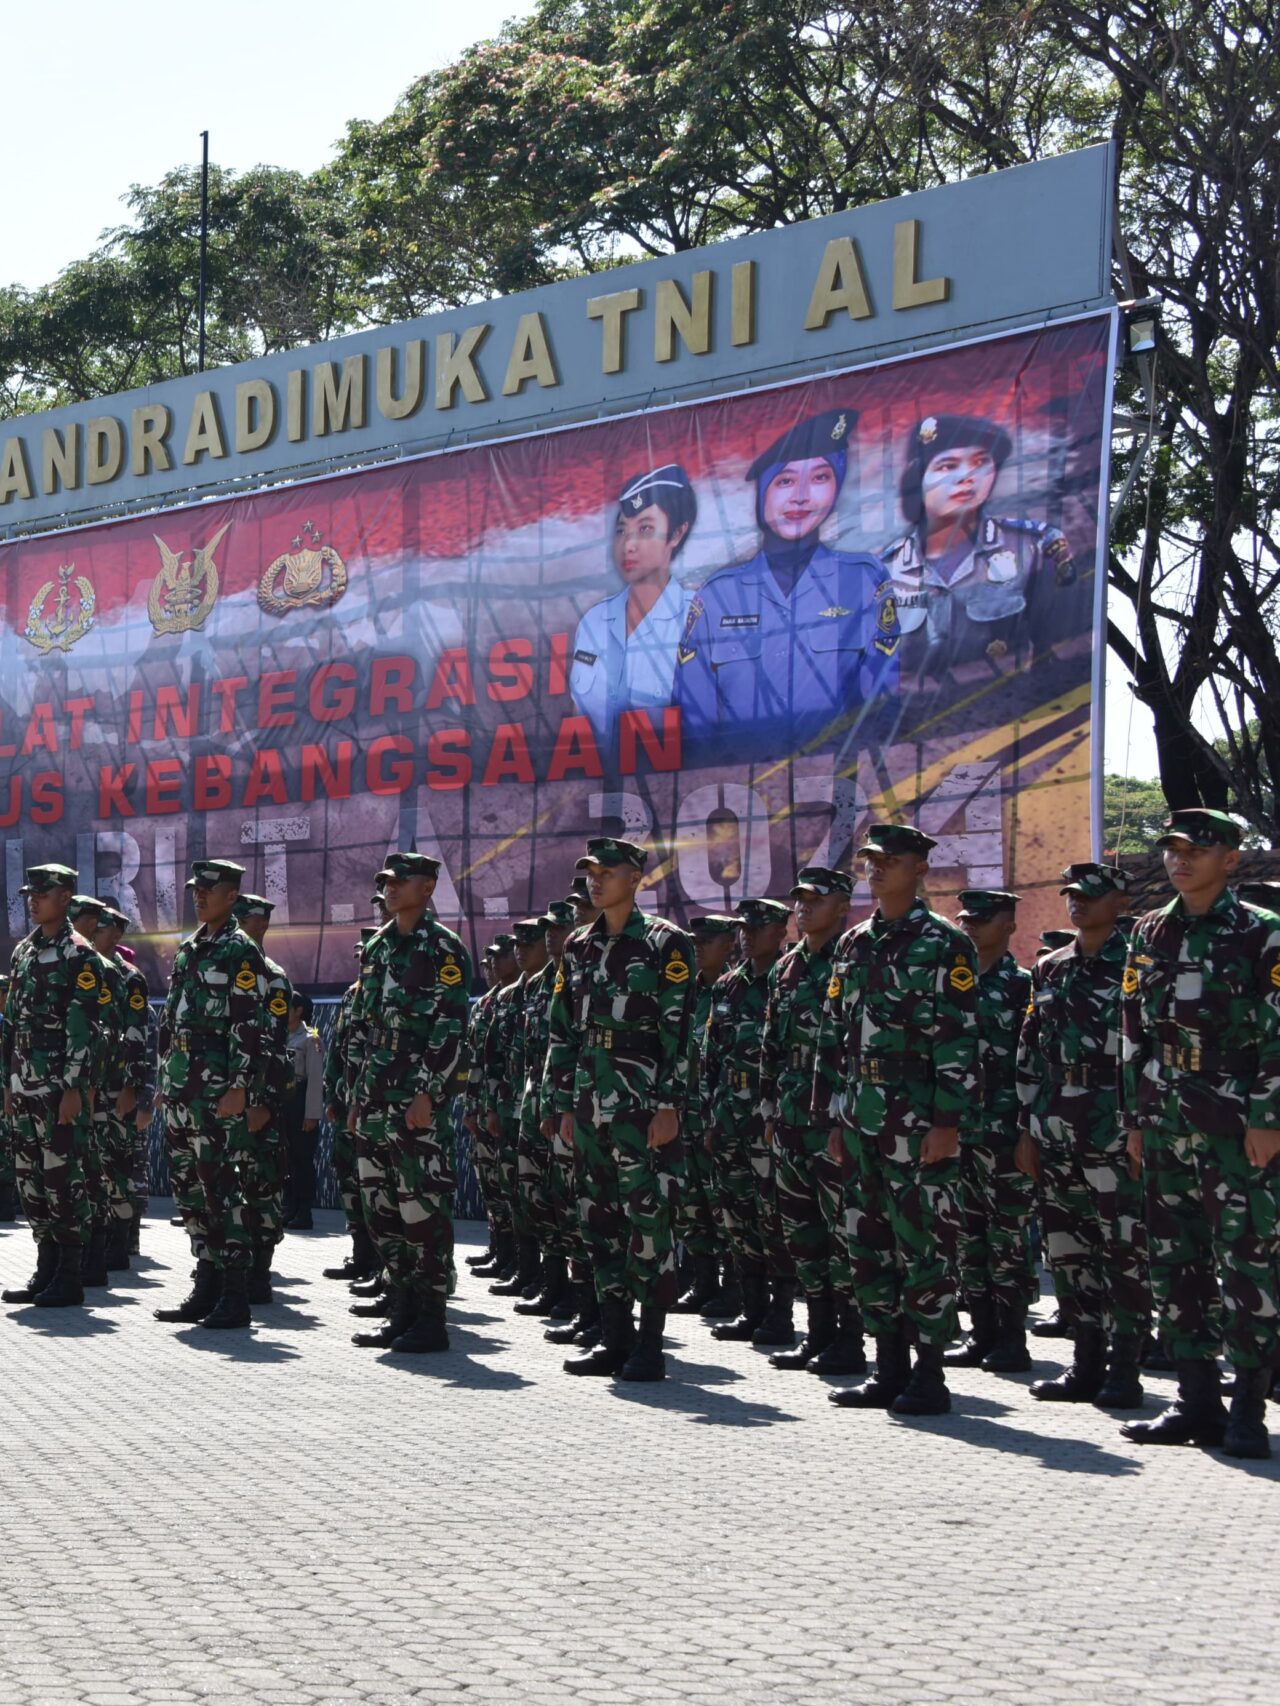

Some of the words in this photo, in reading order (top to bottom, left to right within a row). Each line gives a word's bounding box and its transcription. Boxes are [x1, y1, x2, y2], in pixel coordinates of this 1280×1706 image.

[587, 260, 756, 374] TNI
[804, 219, 951, 331] AL
[127, 633, 570, 745] INTEGRASI
[99, 706, 683, 820] KEBANGSAAN
[588, 760, 1004, 915] 2024
